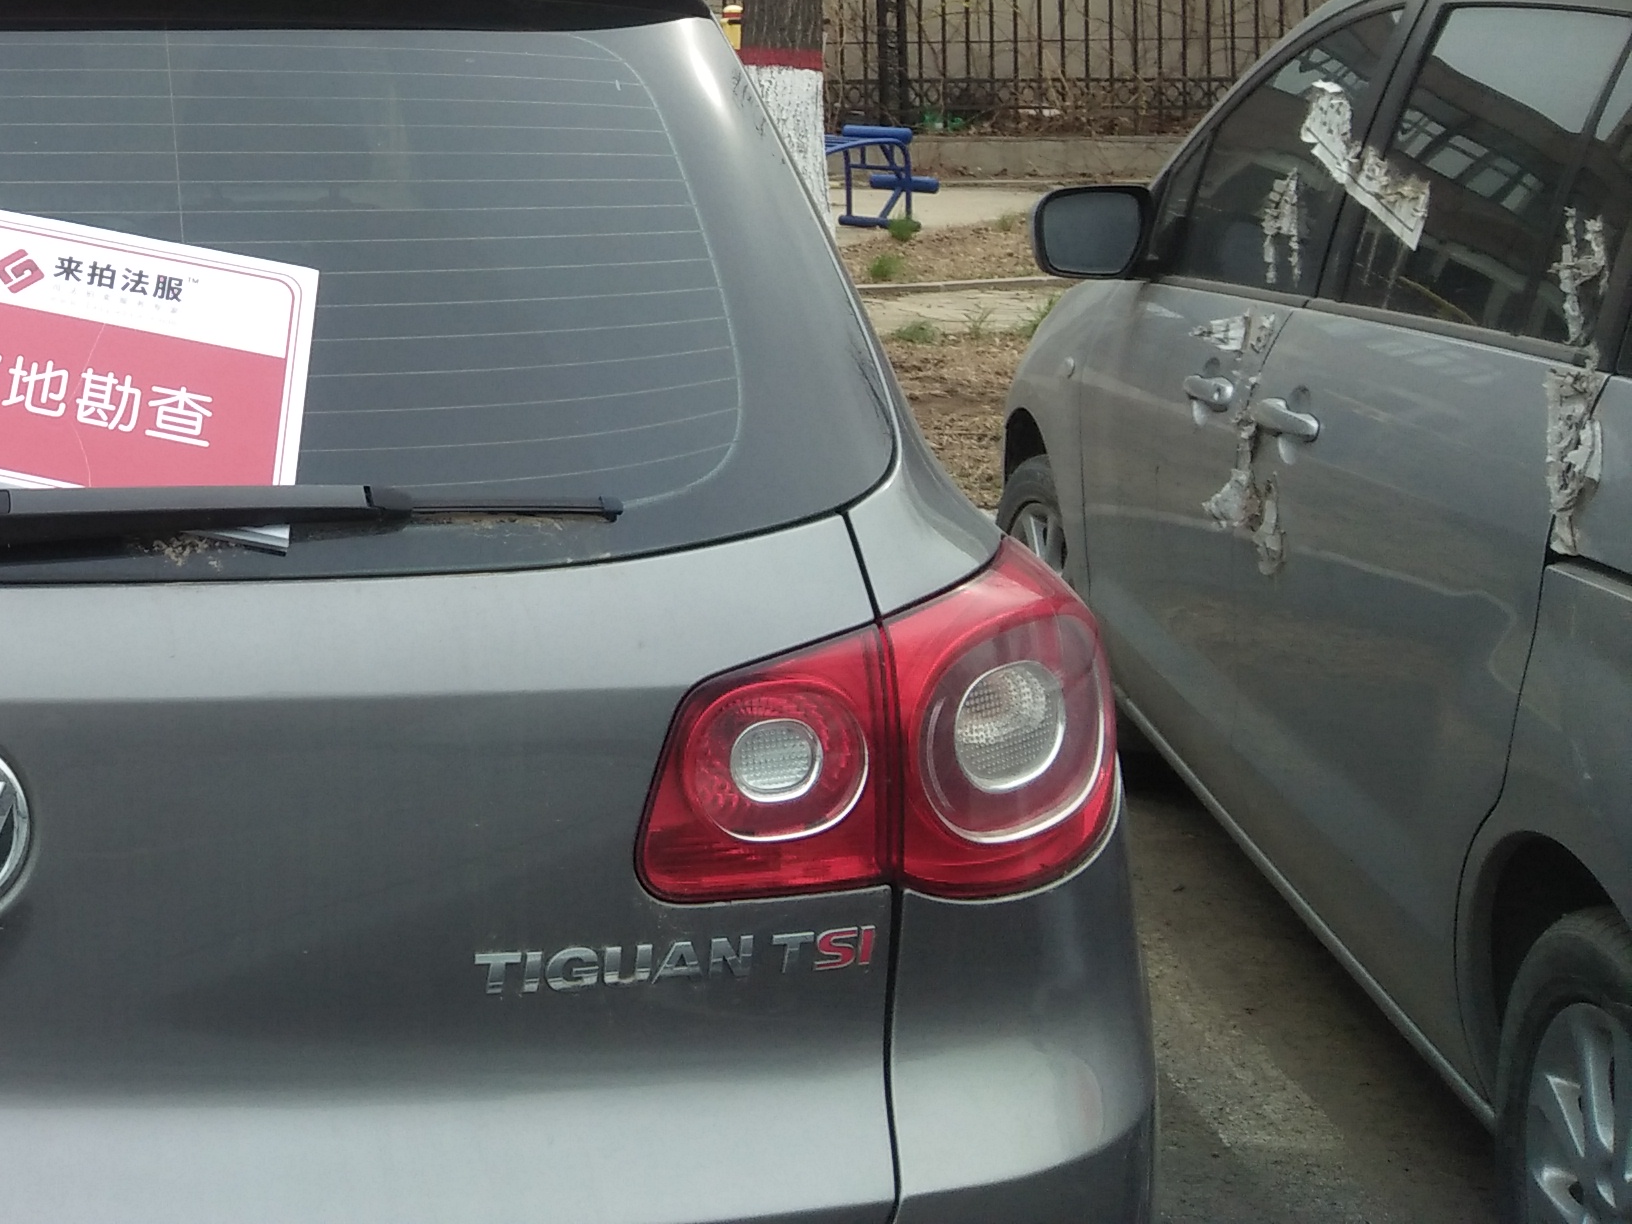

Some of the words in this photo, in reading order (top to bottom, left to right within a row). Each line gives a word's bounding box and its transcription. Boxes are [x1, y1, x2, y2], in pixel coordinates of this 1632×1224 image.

[53, 256, 184, 302] 来拍法服
[475, 935, 754, 994] TIGUAN
[772, 925, 876, 973] TSI
